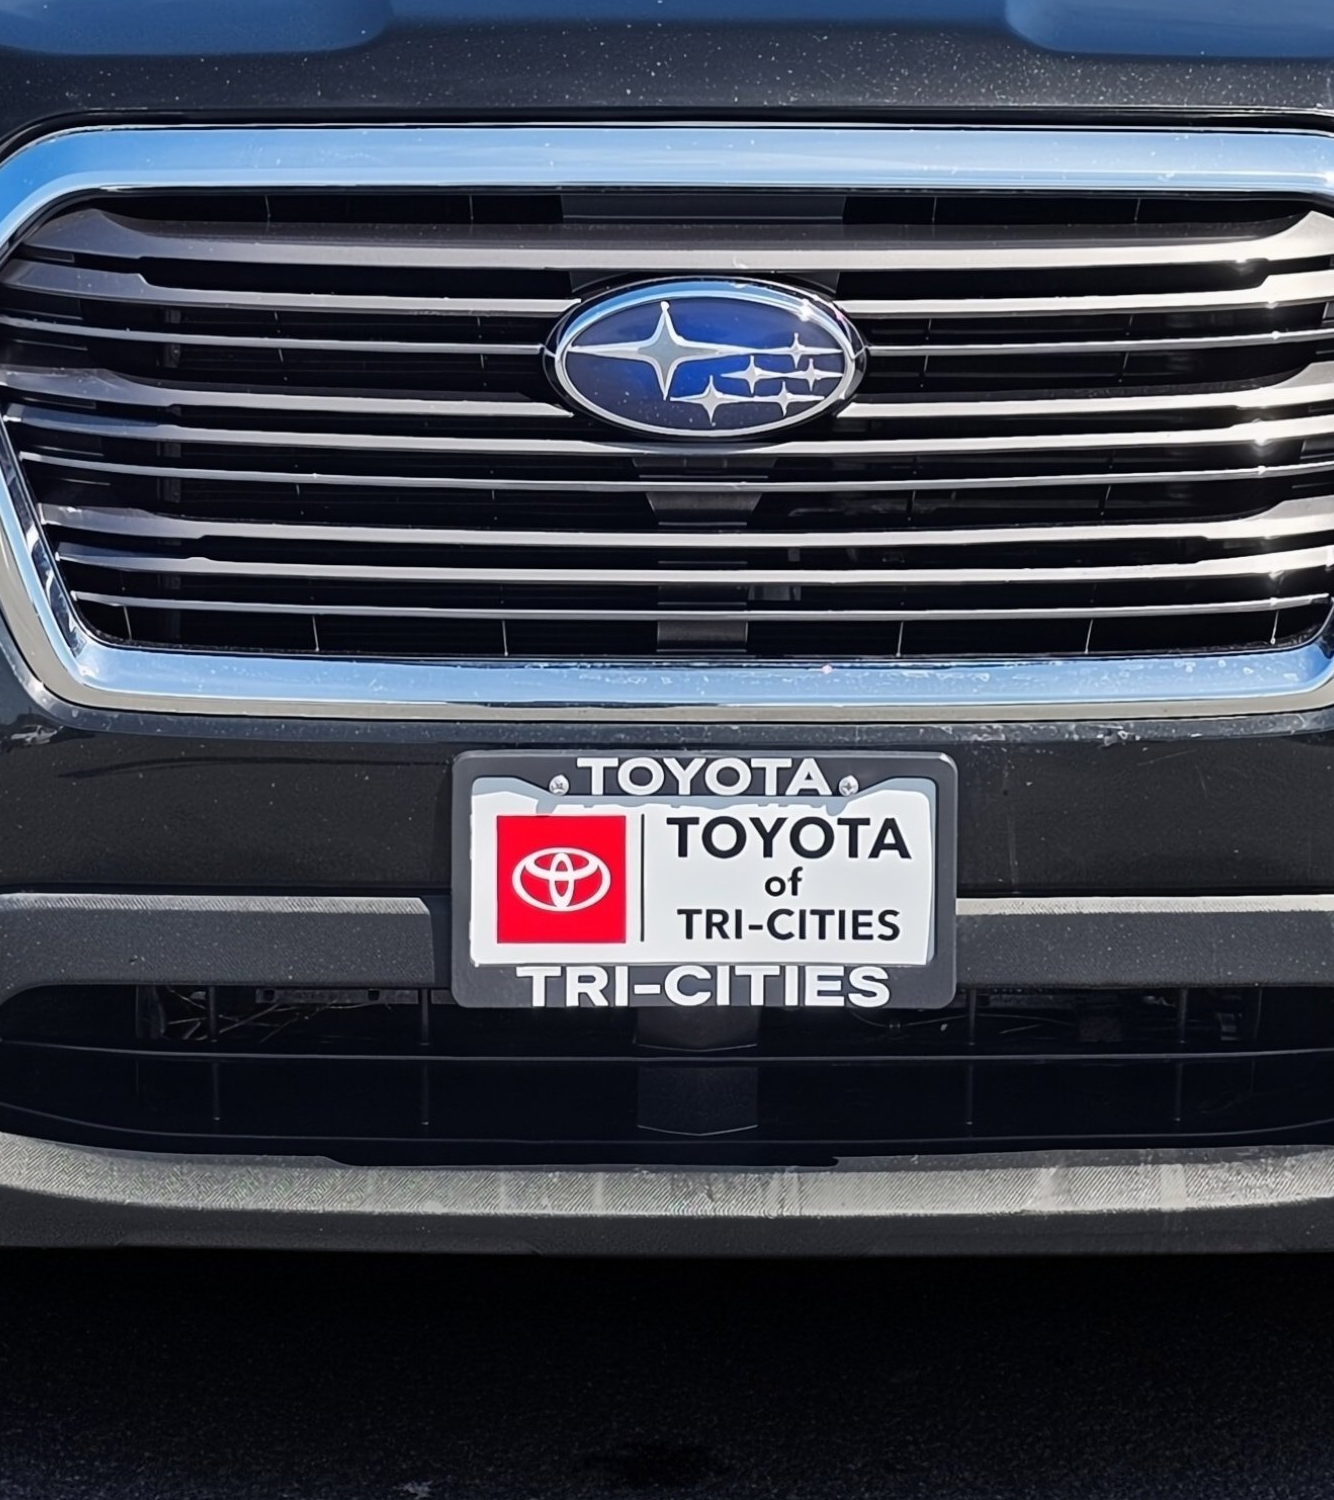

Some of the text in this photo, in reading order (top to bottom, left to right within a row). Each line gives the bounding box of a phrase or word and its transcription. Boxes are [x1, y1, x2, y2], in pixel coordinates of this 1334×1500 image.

[576, 757, 833, 796] TOYOTA
[667, 816, 912, 860] TOYOTA
[764, 867, 803, 897] of
[677, 908, 901, 942] TRI-CITIES
[516, 964, 891, 1008] TRI-CITIES
